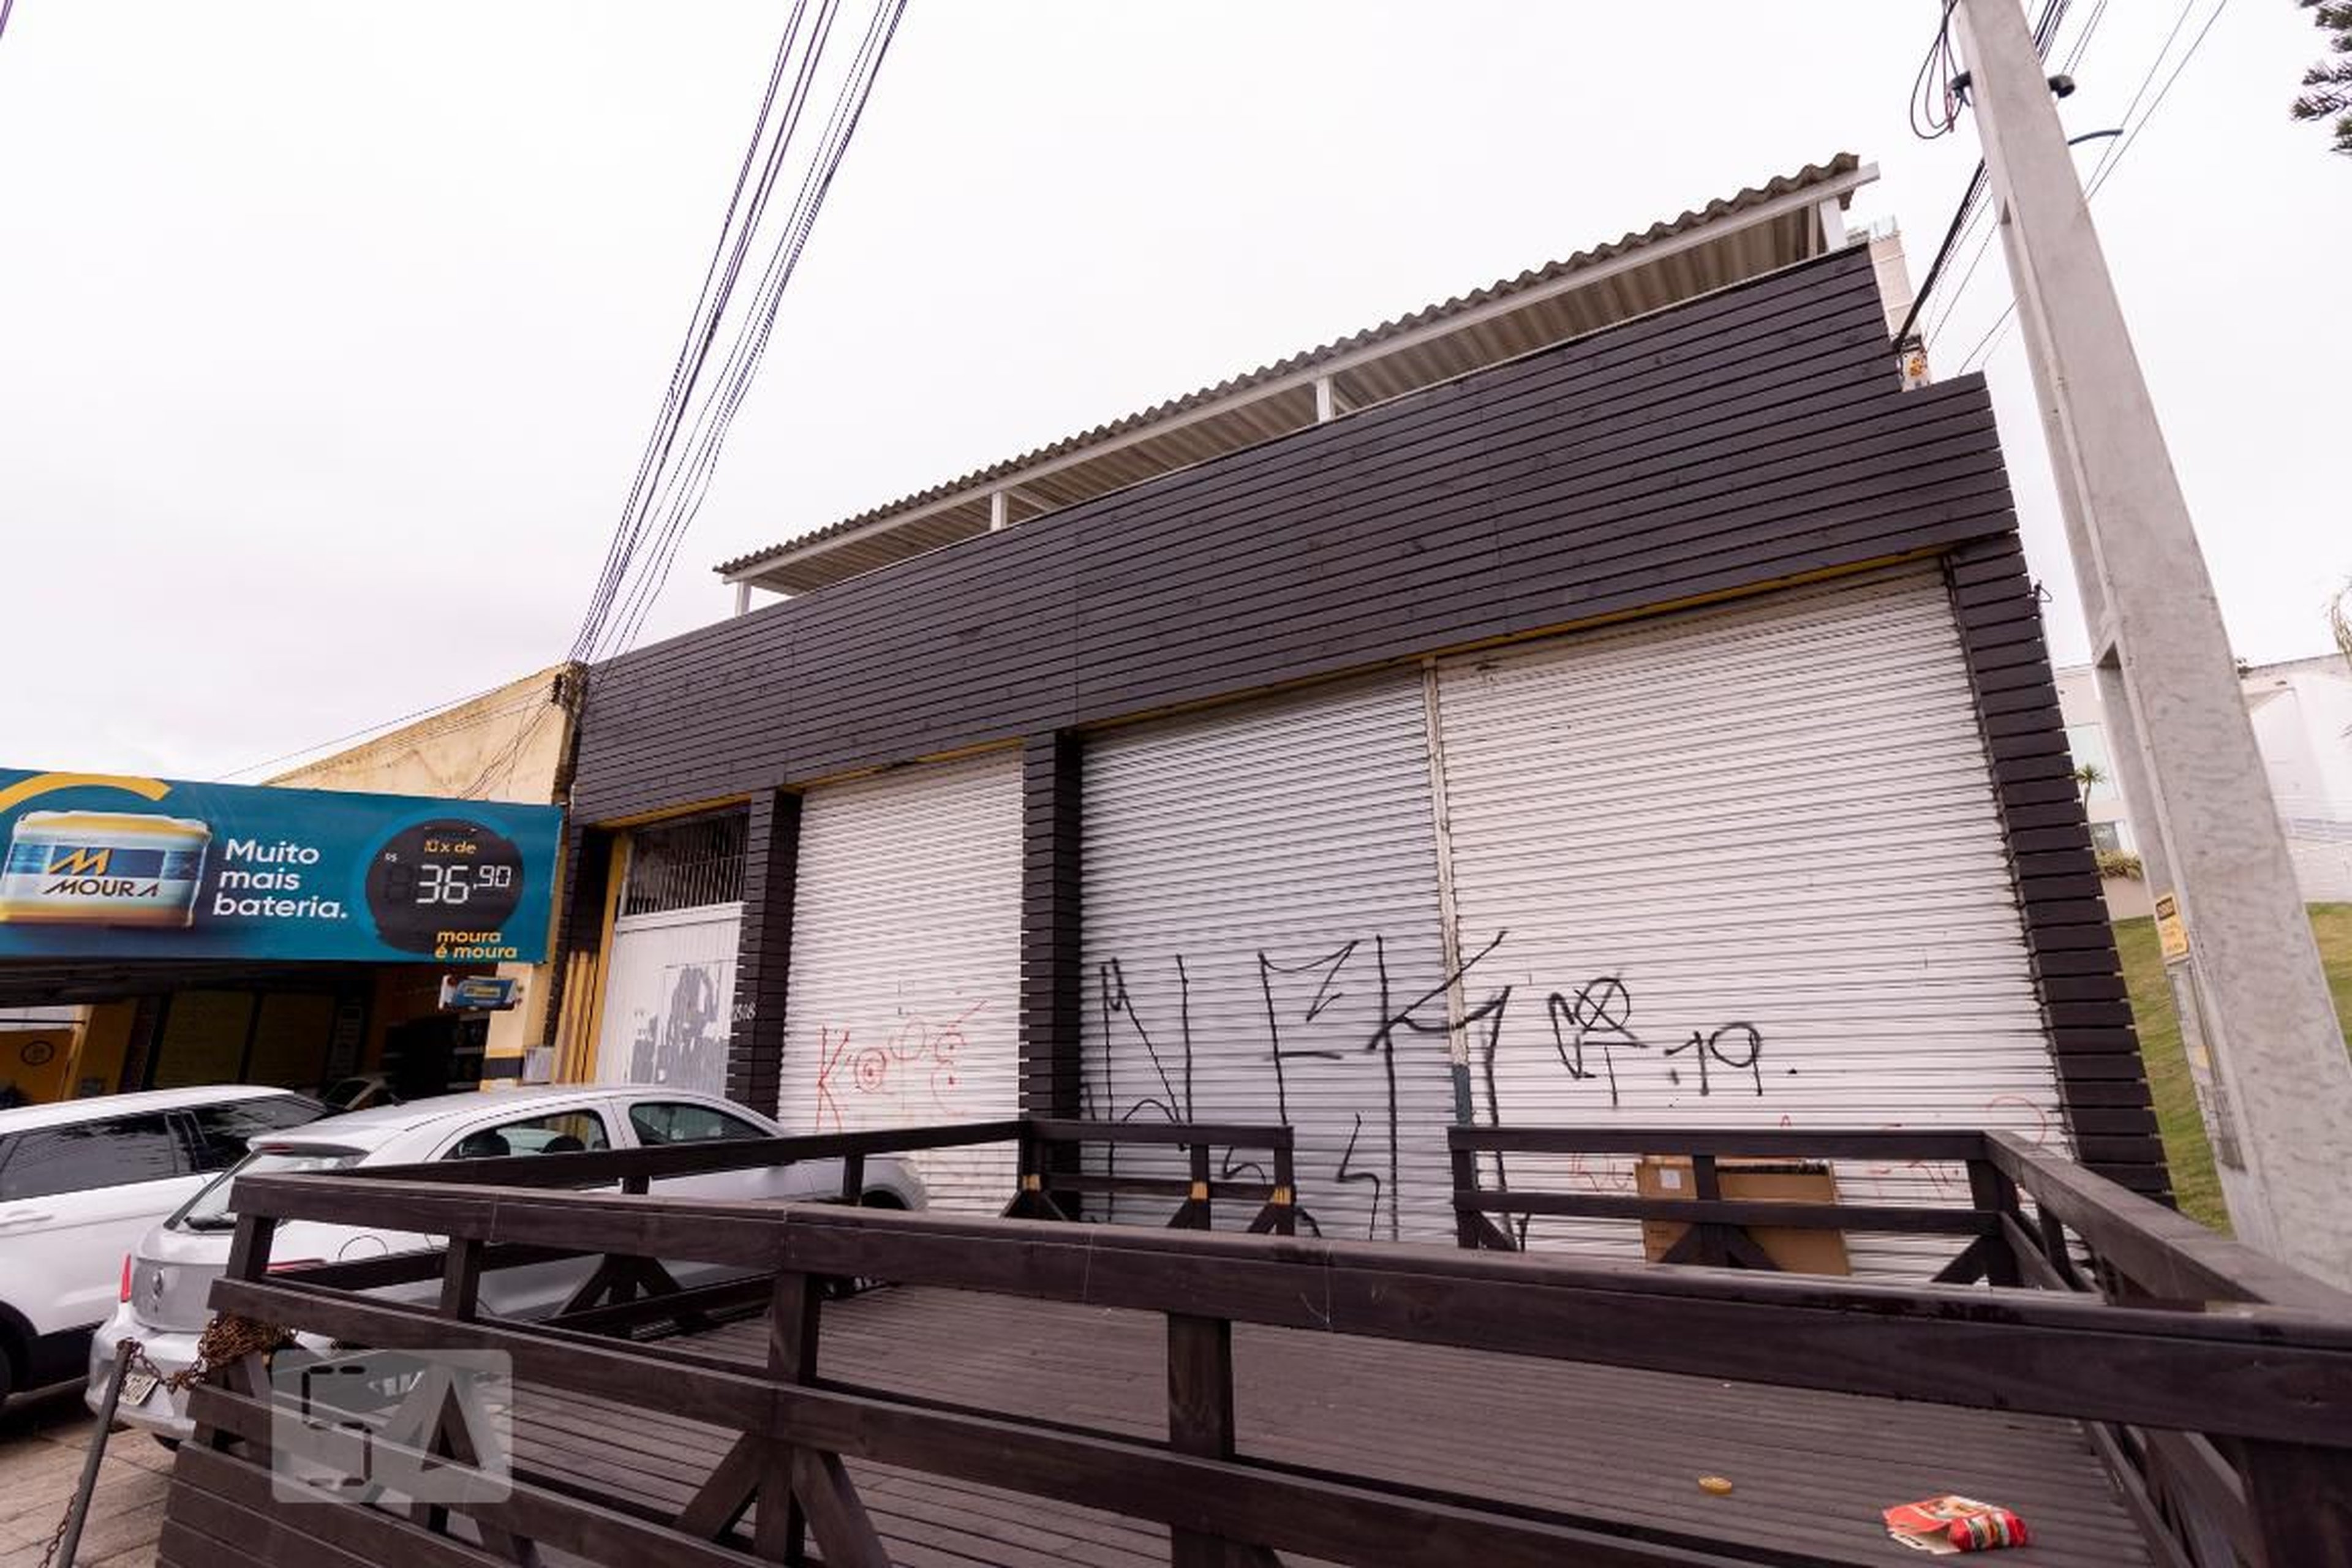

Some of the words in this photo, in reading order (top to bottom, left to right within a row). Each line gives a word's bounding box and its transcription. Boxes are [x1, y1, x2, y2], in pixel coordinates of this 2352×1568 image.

[225, 839, 320, 864] Muito
[454, 842, 477, 854] de
[219, 867, 301, 891] mais
[42, 880, 160, 897] MOURA
[212, 892, 348, 918] bateria.
[437, 931, 502, 943] moura
[453, 946, 518, 959] moura
